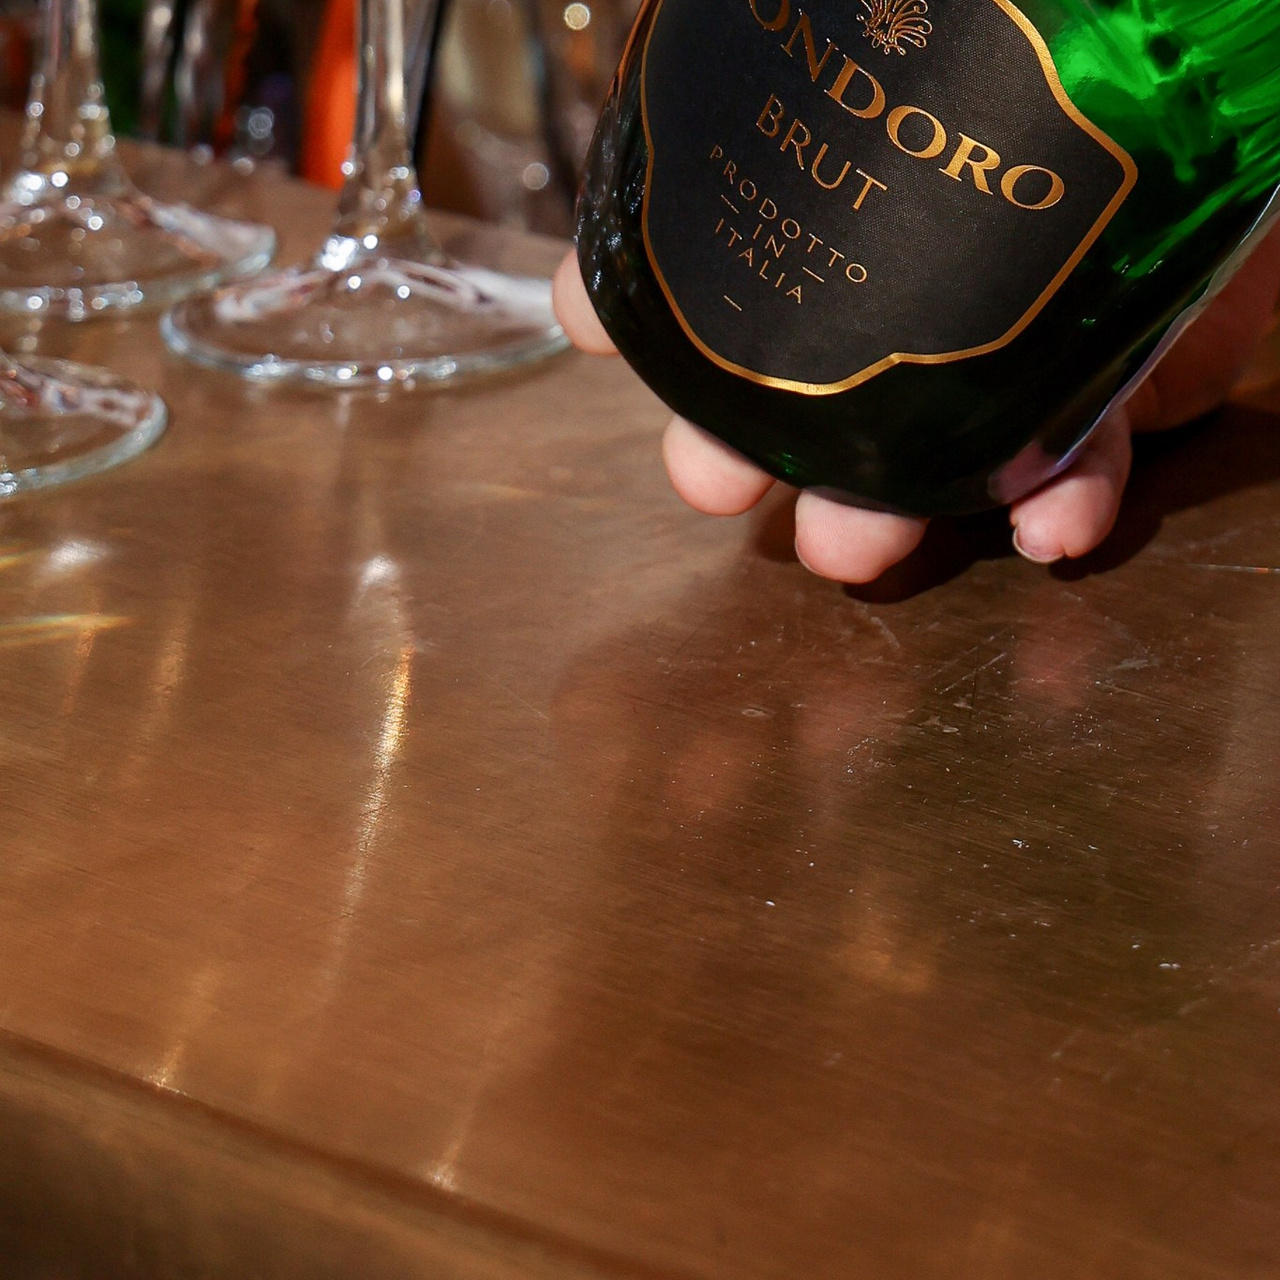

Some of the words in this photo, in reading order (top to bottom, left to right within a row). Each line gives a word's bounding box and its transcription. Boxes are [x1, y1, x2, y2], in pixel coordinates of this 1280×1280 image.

[756, 93, 888, 212] BRUT
[709, 144, 868, 283] PRODOTTO
[715, 218, 803, 304] ITALIA
[752, 223, 786, 259] IN
